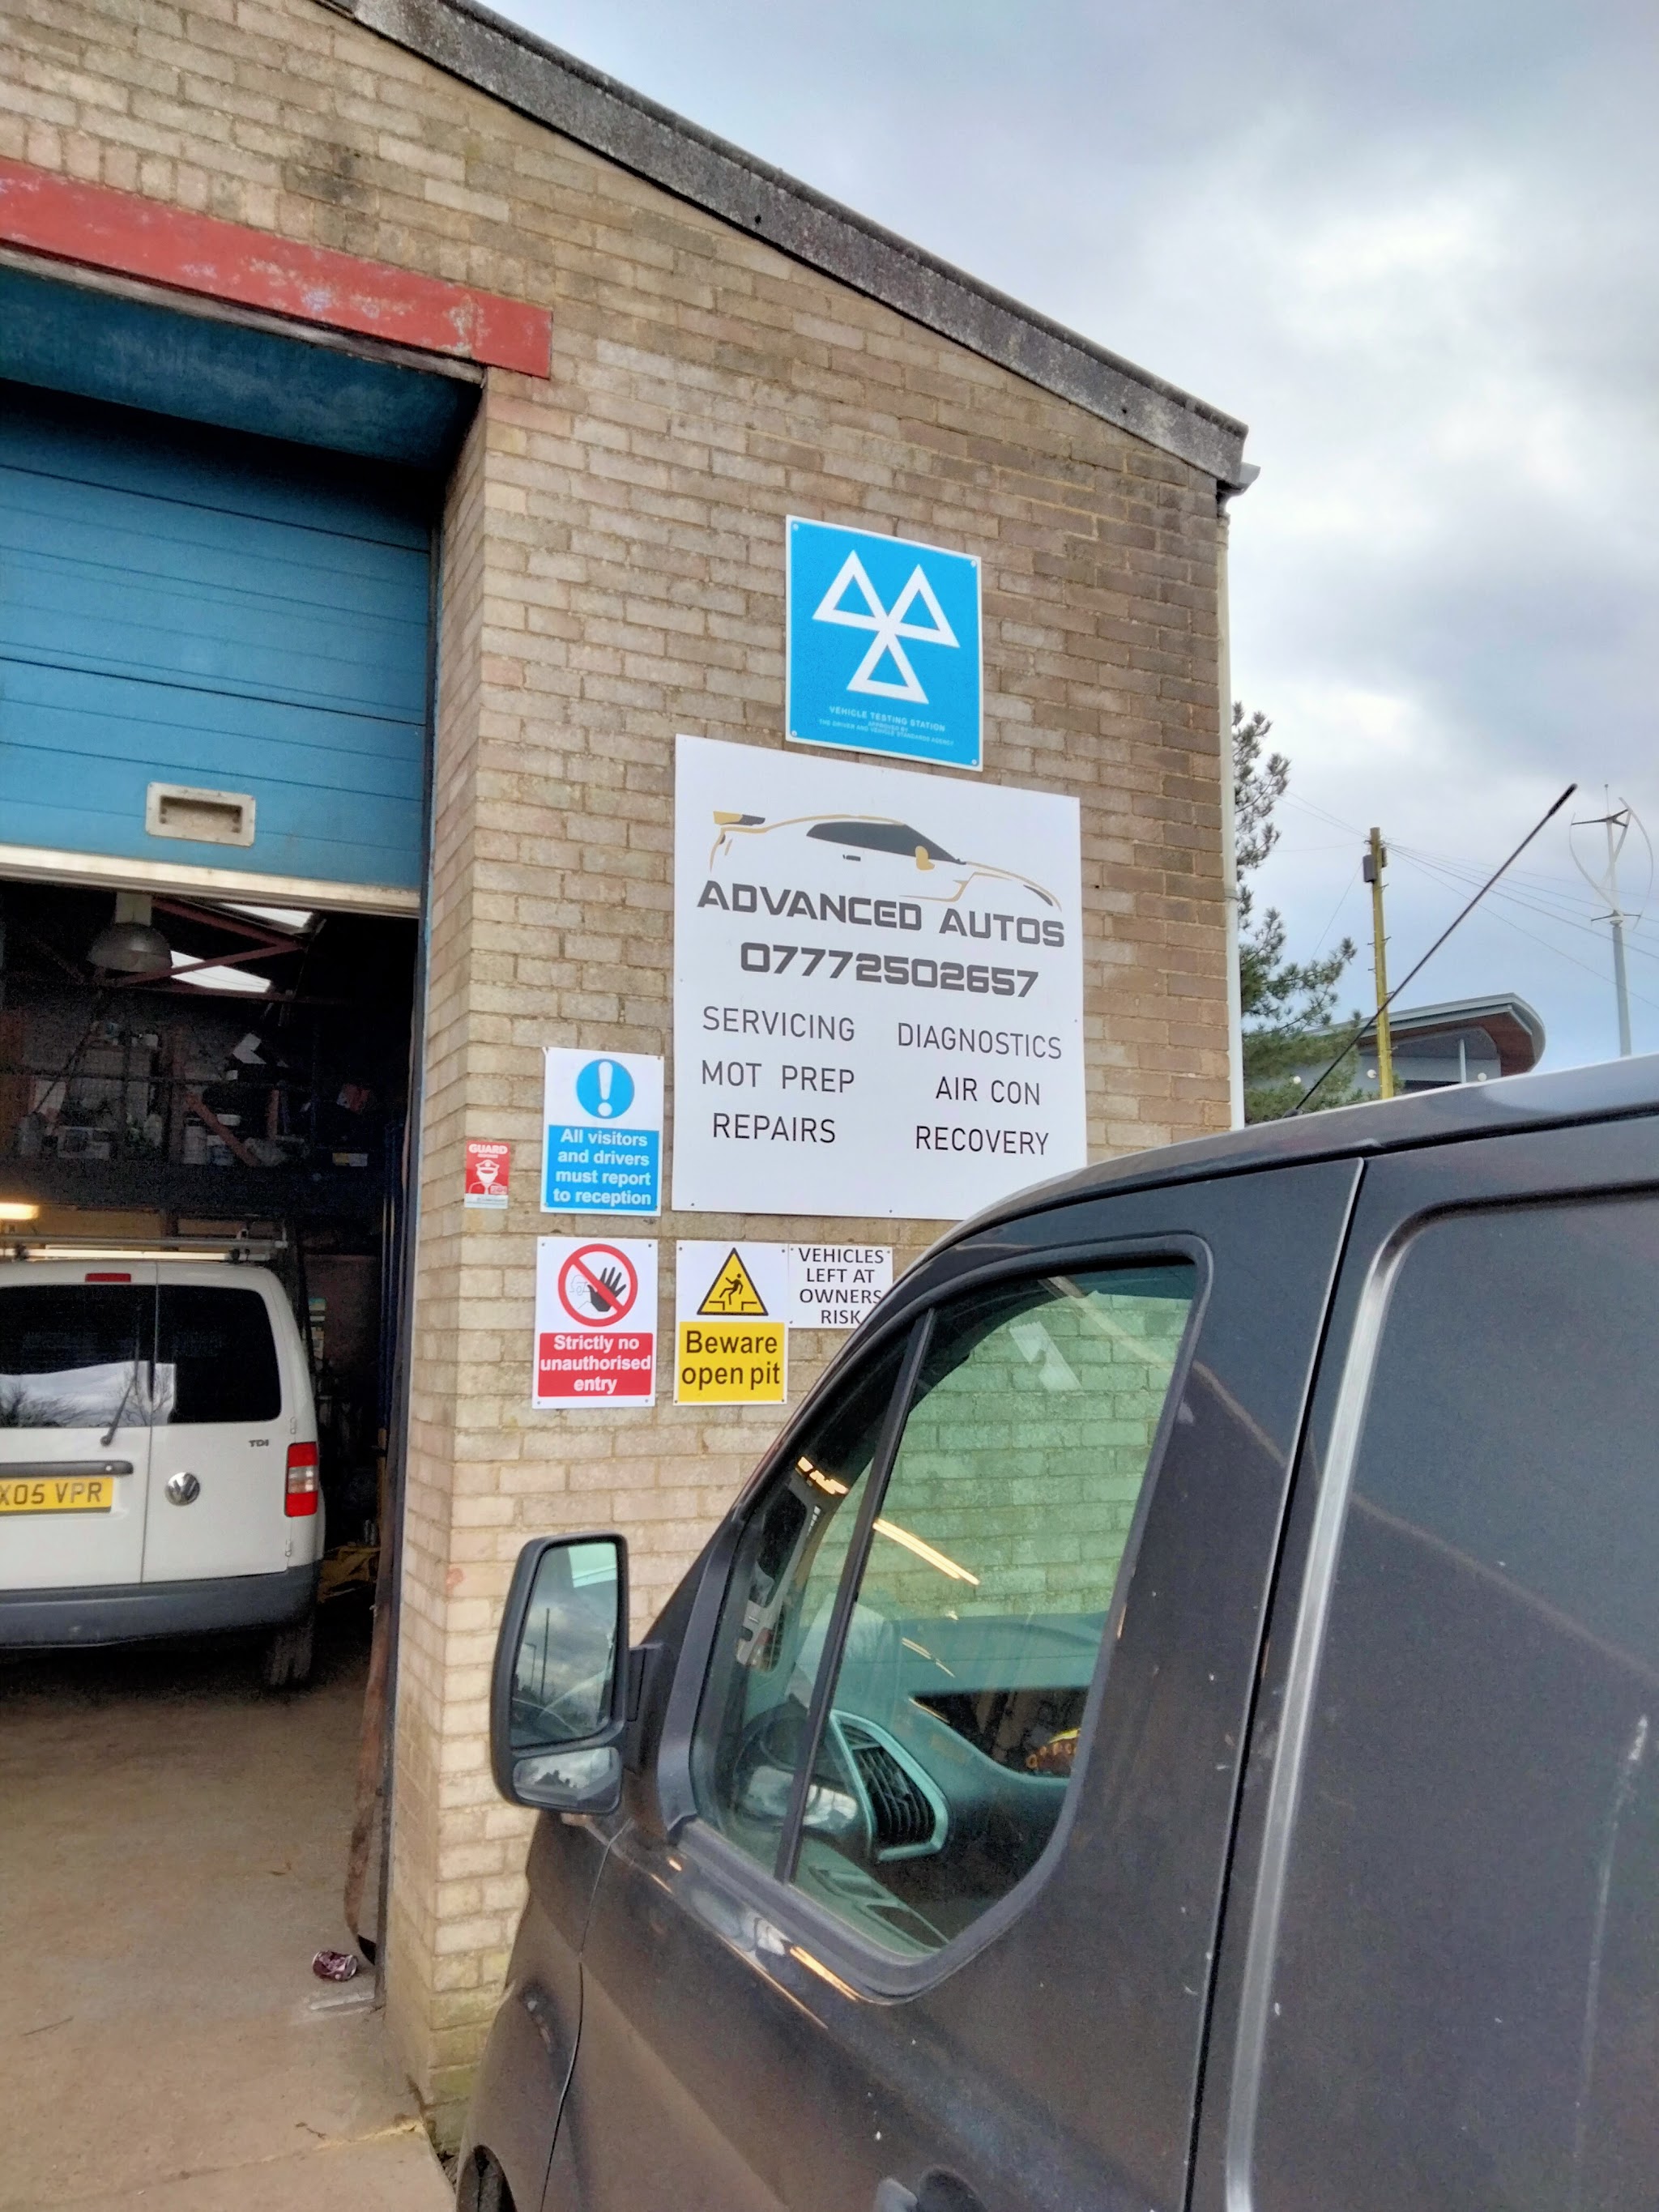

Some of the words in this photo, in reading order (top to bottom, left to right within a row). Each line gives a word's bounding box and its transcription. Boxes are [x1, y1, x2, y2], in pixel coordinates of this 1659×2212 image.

[830, 705, 868, 719] VEHICLE
[870, 711, 907, 726] TESTING
[910, 718, 945, 732] STATION
[697, 880, 922, 931] ADVANCED
[939, 908, 1065, 948] AUTOS
[740, 942, 1038, 998] 07772502657
[702, 1006, 855, 1042] SERVICING
[898, 1023, 1063, 1059] DIAGNOSTICS
[702, 1060, 762, 1088] MOT
[782, 1065, 855, 1093] PREP
[935, 1076, 978, 1102] AIR
[991, 1080, 1041, 1106] CON
[561, 1128, 582, 1144] All
[588, 1131, 648, 1147] visitors
[713, 1113, 836, 1144] REPAIRS
[468, 1144, 508, 1155] GUARD
[915, 1126, 1050, 1156] RECOVERY
[557, 1149, 589, 1163] and
[593, 1150, 650, 1166] drivers
[555, 1170, 598, 1183] must
[602, 1172, 651, 1187] report
[553, 1187, 571, 1203] to
[575, 1190, 651, 1207] reception
[798, 1247, 885, 1264] VEHICLES
[807, 1268, 847, 1282] LEFT
[853, 1269, 875, 1283] AT
[799, 1289, 882, 1304] OWNERS
[821, 1310, 861, 1324] RISK
[553, 1334, 614, 1353] Strictly
[618, 1337, 640, 1350] no
[686, 1330, 778, 1353] Beware
[539, 1354, 651, 1371] unauthorised
[573, 1375, 618, 1395] entry
[681, 1366, 744, 1391] open
[750, 1361, 780, 1390] pit
[249, 1438, 270, 1447] TDI
[54, 1481, 102, 1503] VPR
